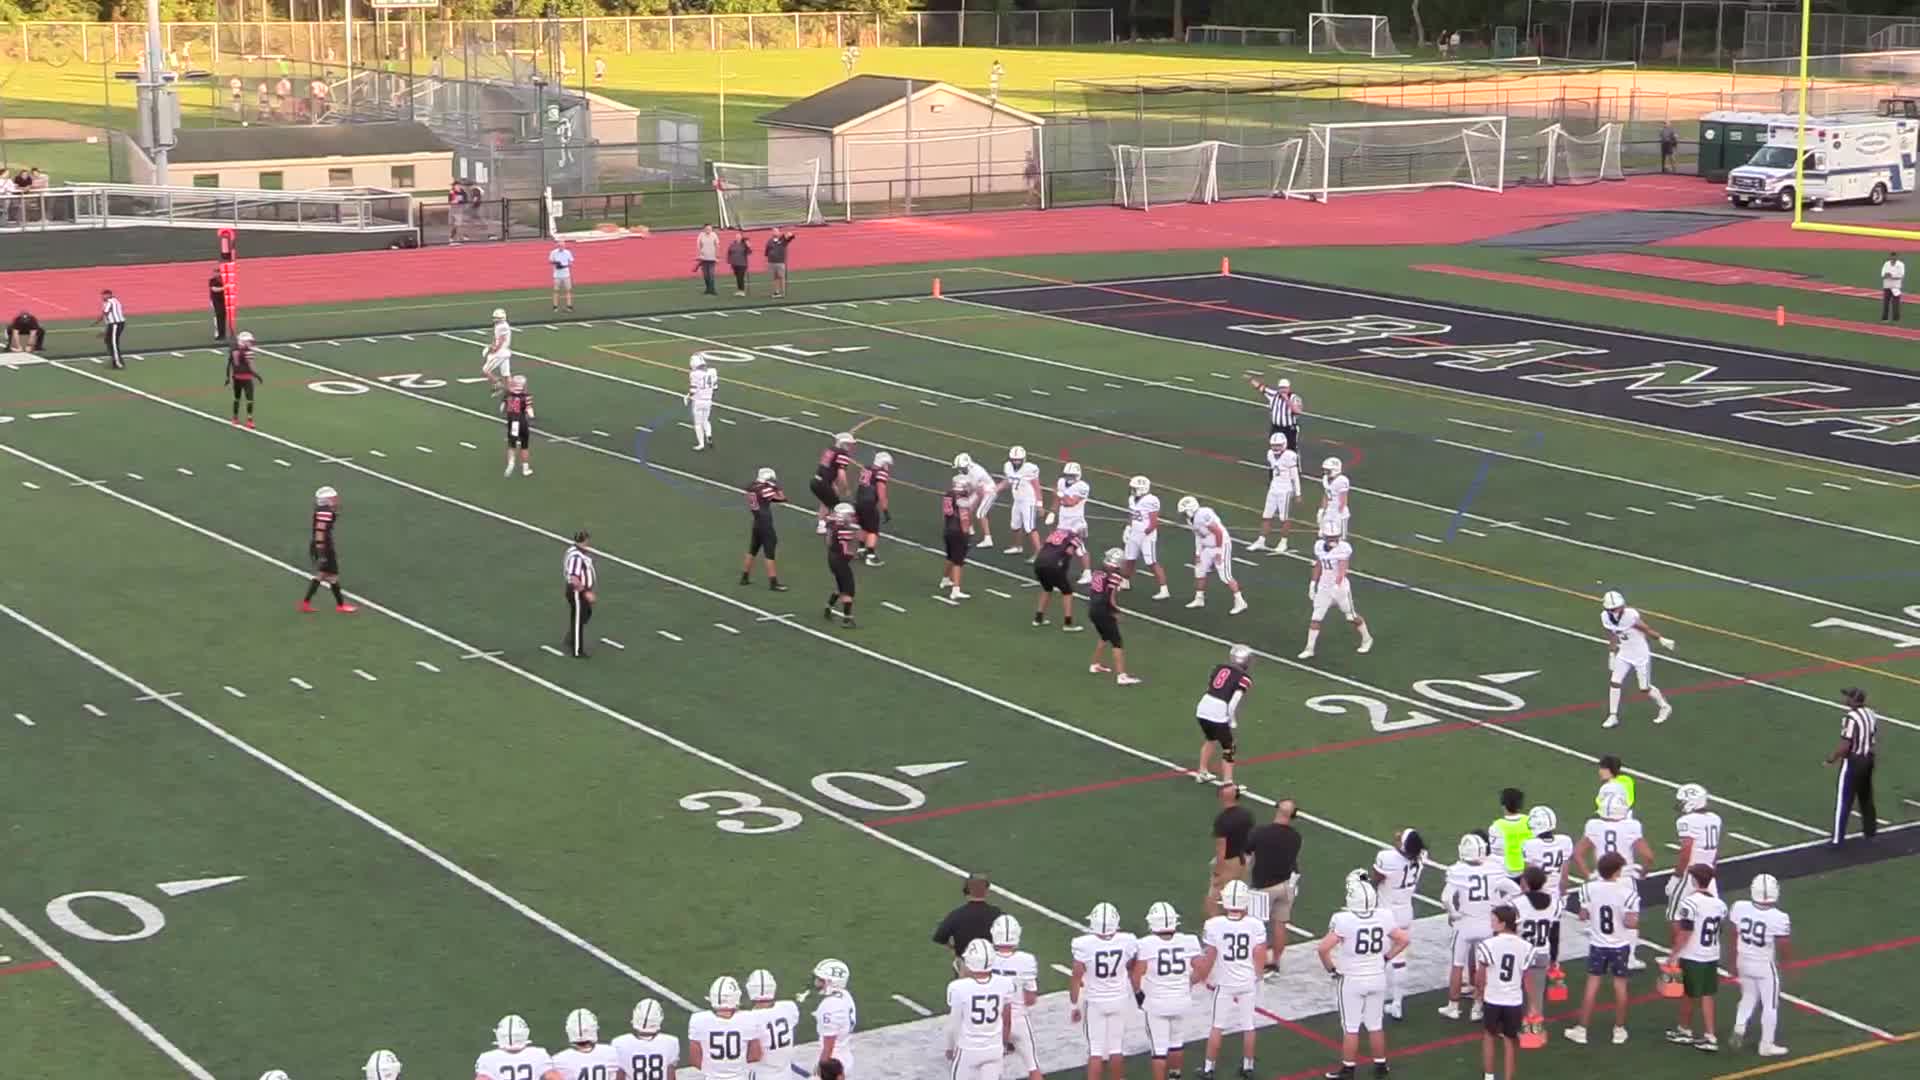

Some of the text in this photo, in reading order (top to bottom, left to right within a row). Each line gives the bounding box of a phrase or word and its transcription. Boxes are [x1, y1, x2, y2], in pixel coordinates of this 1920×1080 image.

[1212, 667, 1231, 689] 8
[1305, 679, 1526, 733] 20
[679, 771, 926, 834] 30
[1604, 829, 1618, 852] 8
[1704, 824, 1718, 850] 10
[1400, 863, 1420, 889] 13
[1542, 849, 1564, 875] 24
[1468, 874, 1490, 901] 21
[1522, 918, 1550, 947] 20
[1599, 905, 1614, 935] 8
[1740, 917, 1767, 947] 29
[1222, 933, 1250, 962] 38
[1354, 927, 1384, 955] 68
[1095, 949, 1124, 979] 67
[1156, 947, 1186, 977] 65
[1499, 953, 1515, 982] 9
[970, 994, 1000, 1025] 53
[709, 1031, 741, 1060] 50
[766, 1017, 791, 1050] 12
[632, 1053, 664, 1080] 88
